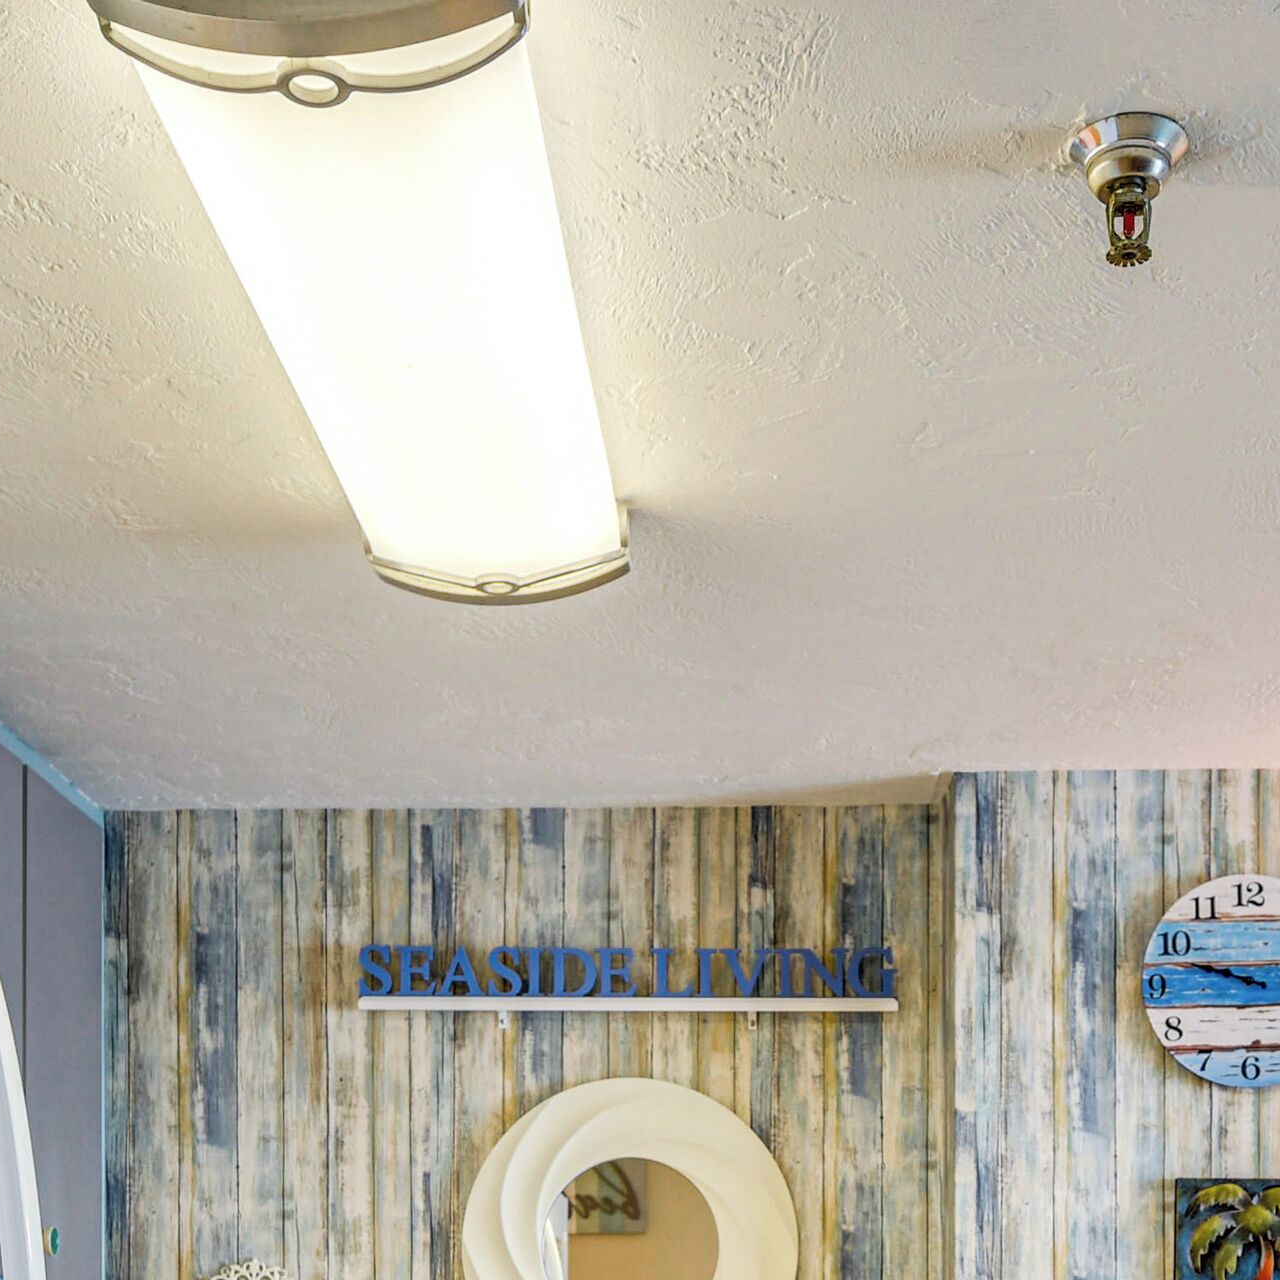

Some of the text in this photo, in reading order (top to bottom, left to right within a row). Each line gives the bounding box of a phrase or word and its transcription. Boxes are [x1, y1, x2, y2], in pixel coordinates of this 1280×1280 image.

[1231, 881, 1265, 907] 12
[1192, 896, 1218, 920] 11
[1157, 930, 1191, 957] 10
[358, 944, 898, 997] SEASIDE LIVING
[1148, 973, 1167, 1000] 9
[1164, 1016, 1183, 1042] 8
[1197, 1049, 1214, 1072] 7
[1240, 1055, 1261, 1081] 6
